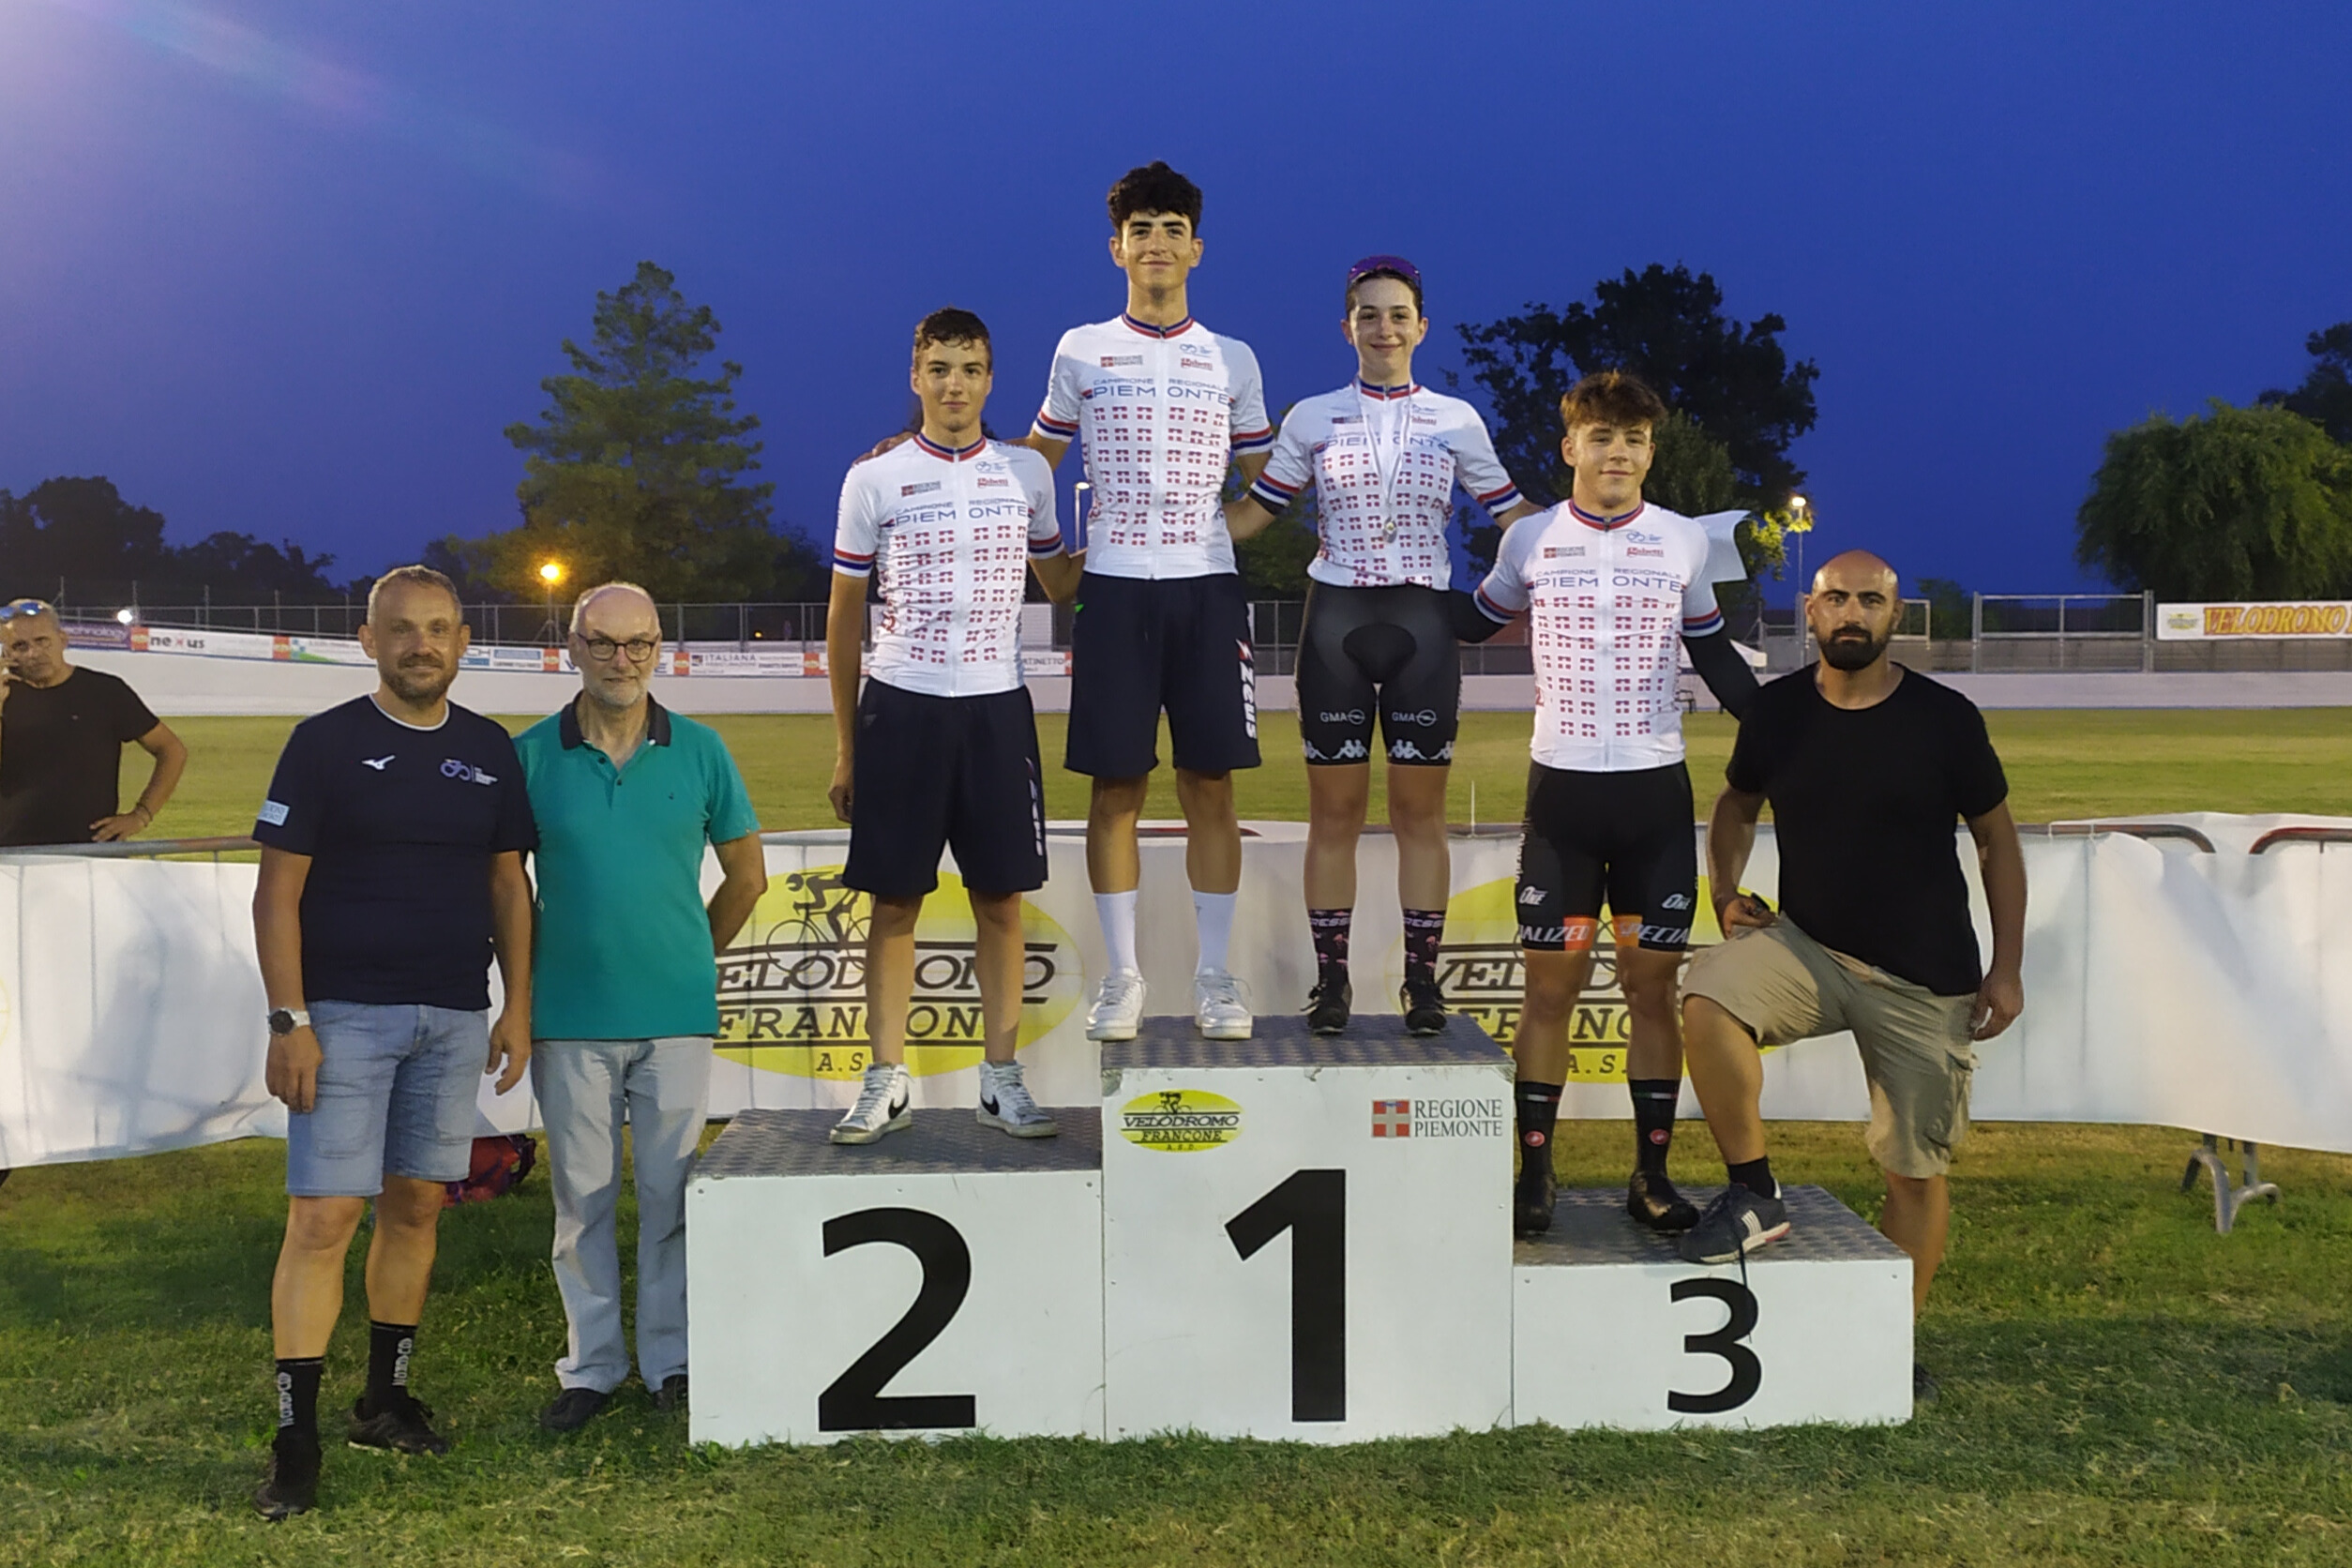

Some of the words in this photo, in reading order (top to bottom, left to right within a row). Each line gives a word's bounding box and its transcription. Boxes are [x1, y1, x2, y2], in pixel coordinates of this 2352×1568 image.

[1535, 568, 1597, 577] CAMPIONE
[1613, 567, 1681, 579] REGIONALE
[2204, 606, 2345, 635] VELODROMO
[1319, 712, 1348, 723] GMA
[1392, 712, 1415, 722] GMA
[1619, 922, 1689, 943] SPECIA
[1414, 1099, 1503, 1119] REGIONE
[1123, 1115, 1240, 1127] VELODROMO
[1414, 1120, 1503, 1138] PIEMONTE
[1140, 1130, 1223, 1142] FRANCONE
[1224, 1168, 1347, 1423] 1
[819, 1207, 976, 1432] 2
[1667, 1277, 1762, 1414] 3
